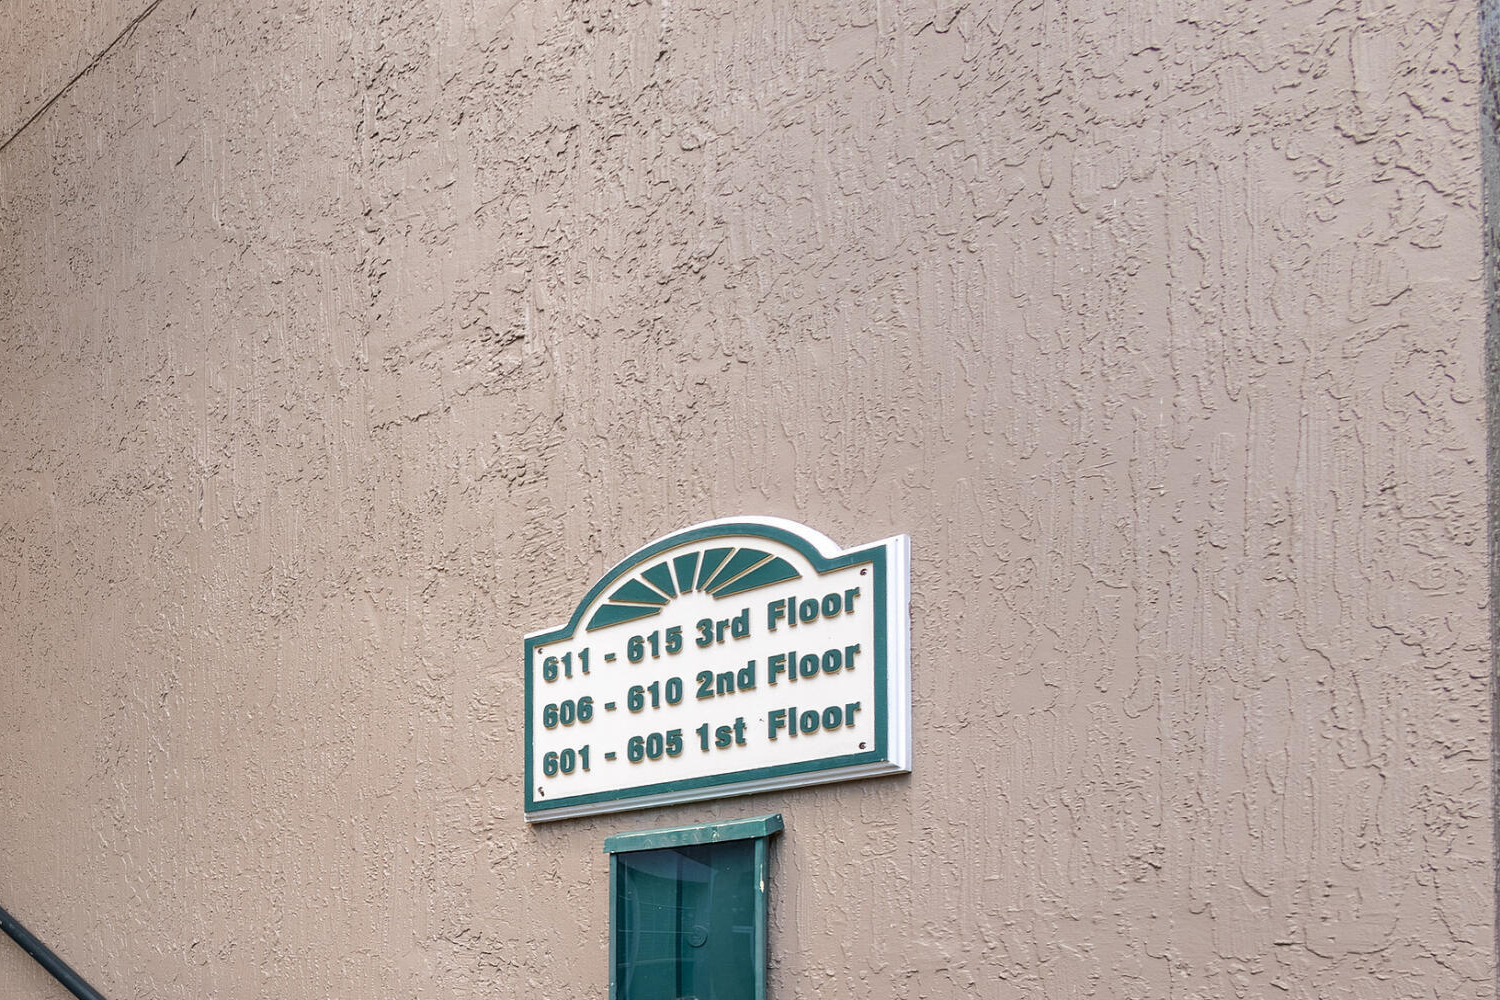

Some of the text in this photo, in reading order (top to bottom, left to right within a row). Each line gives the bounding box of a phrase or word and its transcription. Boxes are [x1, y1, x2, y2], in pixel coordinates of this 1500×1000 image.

[541, 586, 861, 683] 611 - 615 3rd Floor
[542, 643, 861, 729] 606 - 610 2nd Floor
[542, 701, 862, 777] 601 - 605 1st Floor
